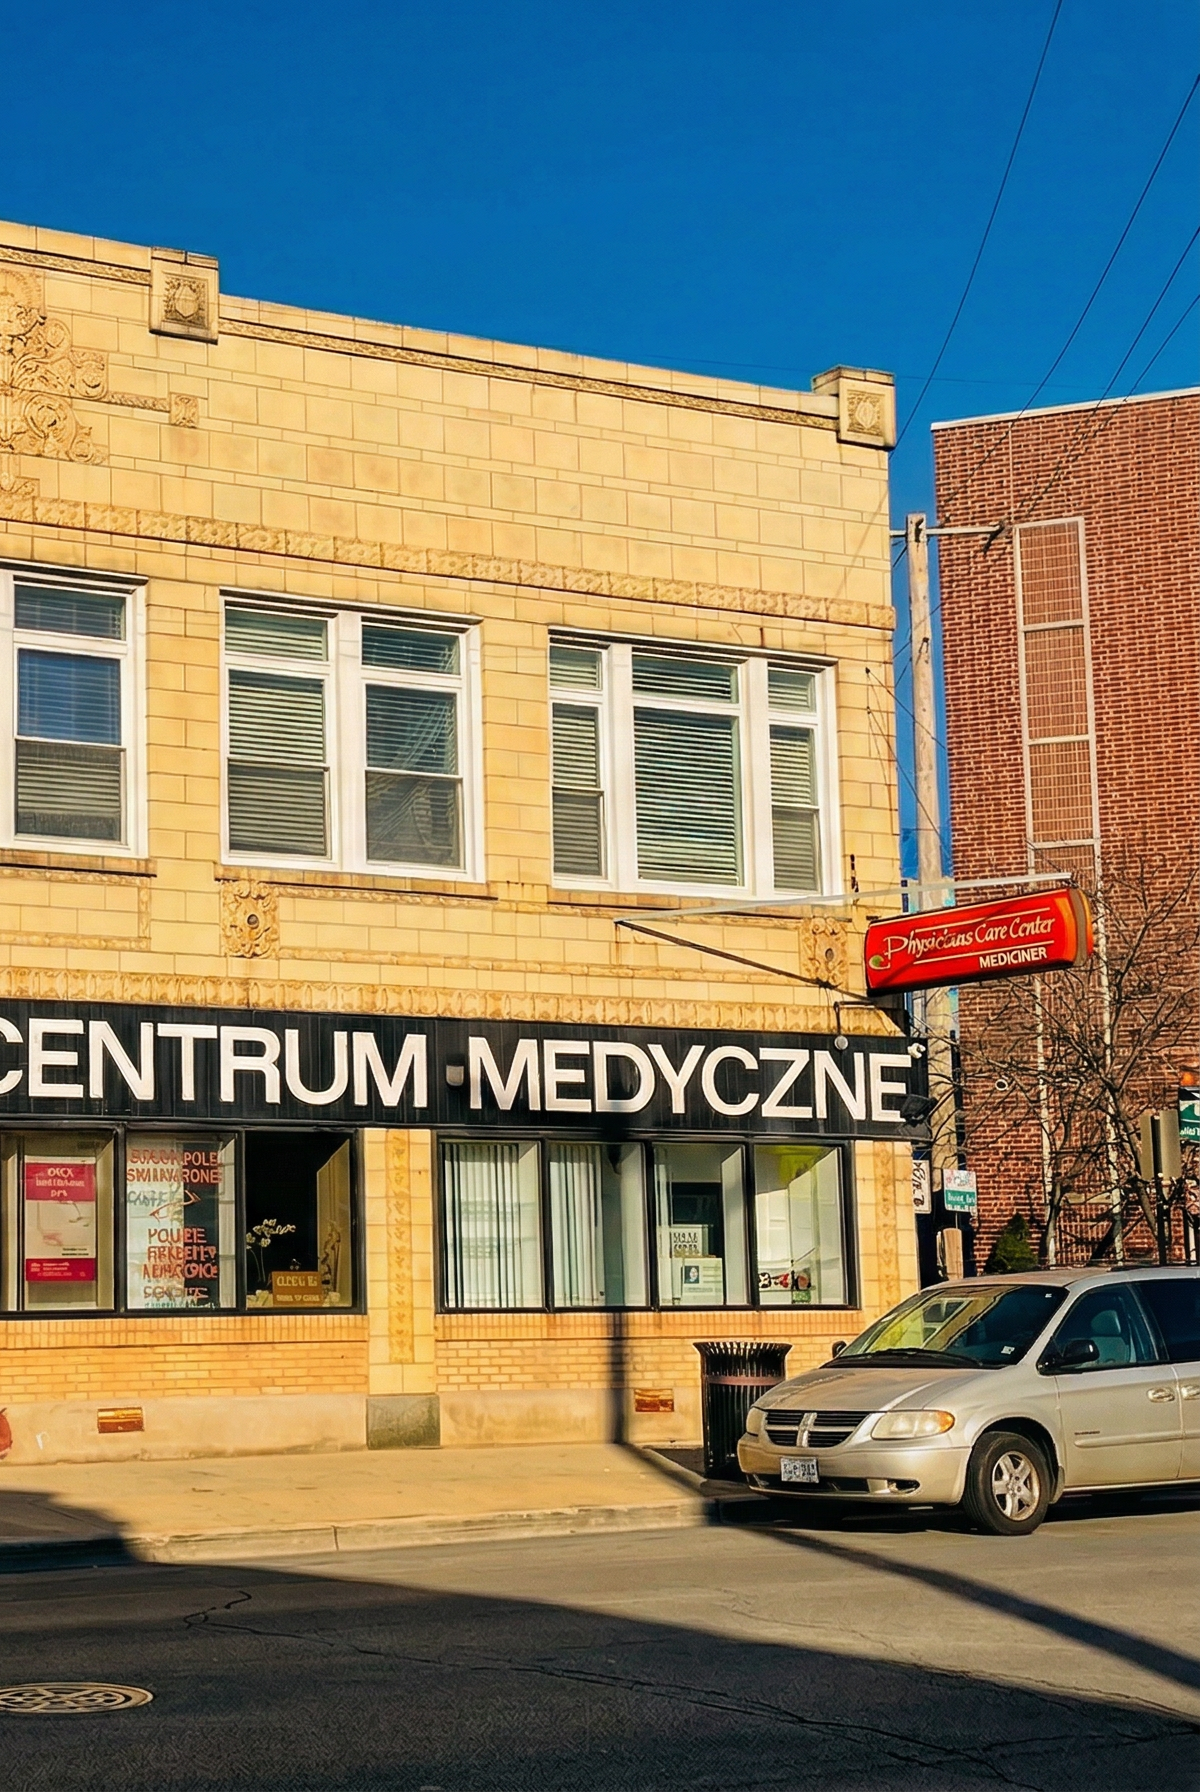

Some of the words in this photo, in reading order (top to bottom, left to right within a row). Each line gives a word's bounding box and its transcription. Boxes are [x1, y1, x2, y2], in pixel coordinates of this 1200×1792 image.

[975, 923, 1007, 945] Care
[1009, 917, 1056, 940] Center
[979, 947, 1048, 969] MEDICINER
[469, 1035, 912, 1123] MEDYCZNE
